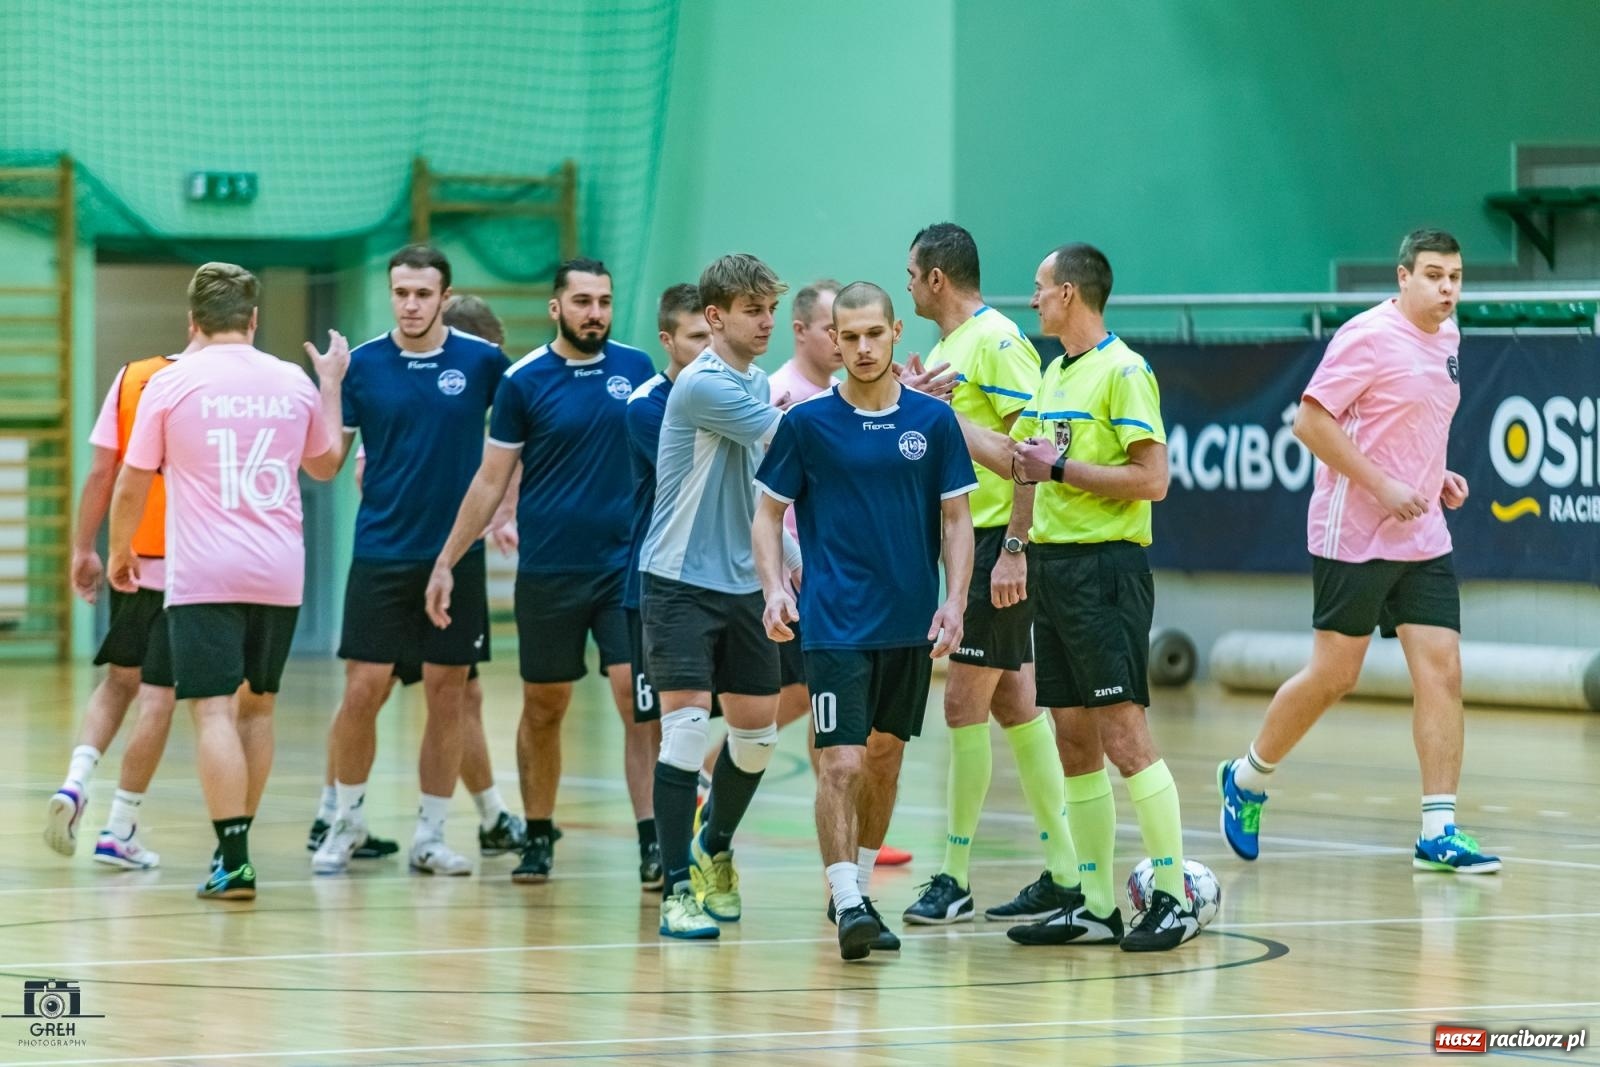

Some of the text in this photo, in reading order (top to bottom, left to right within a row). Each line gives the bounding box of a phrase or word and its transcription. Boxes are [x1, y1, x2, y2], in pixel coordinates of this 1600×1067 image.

[201, 395, 297, 420] MICHAŁ
[1168, 402, 1313, 493] ACIBÓ
[1489, 395, 1600, 488] OSi
[207, 427, 291, 510] 16
[811, 691, 837, 734] 10
